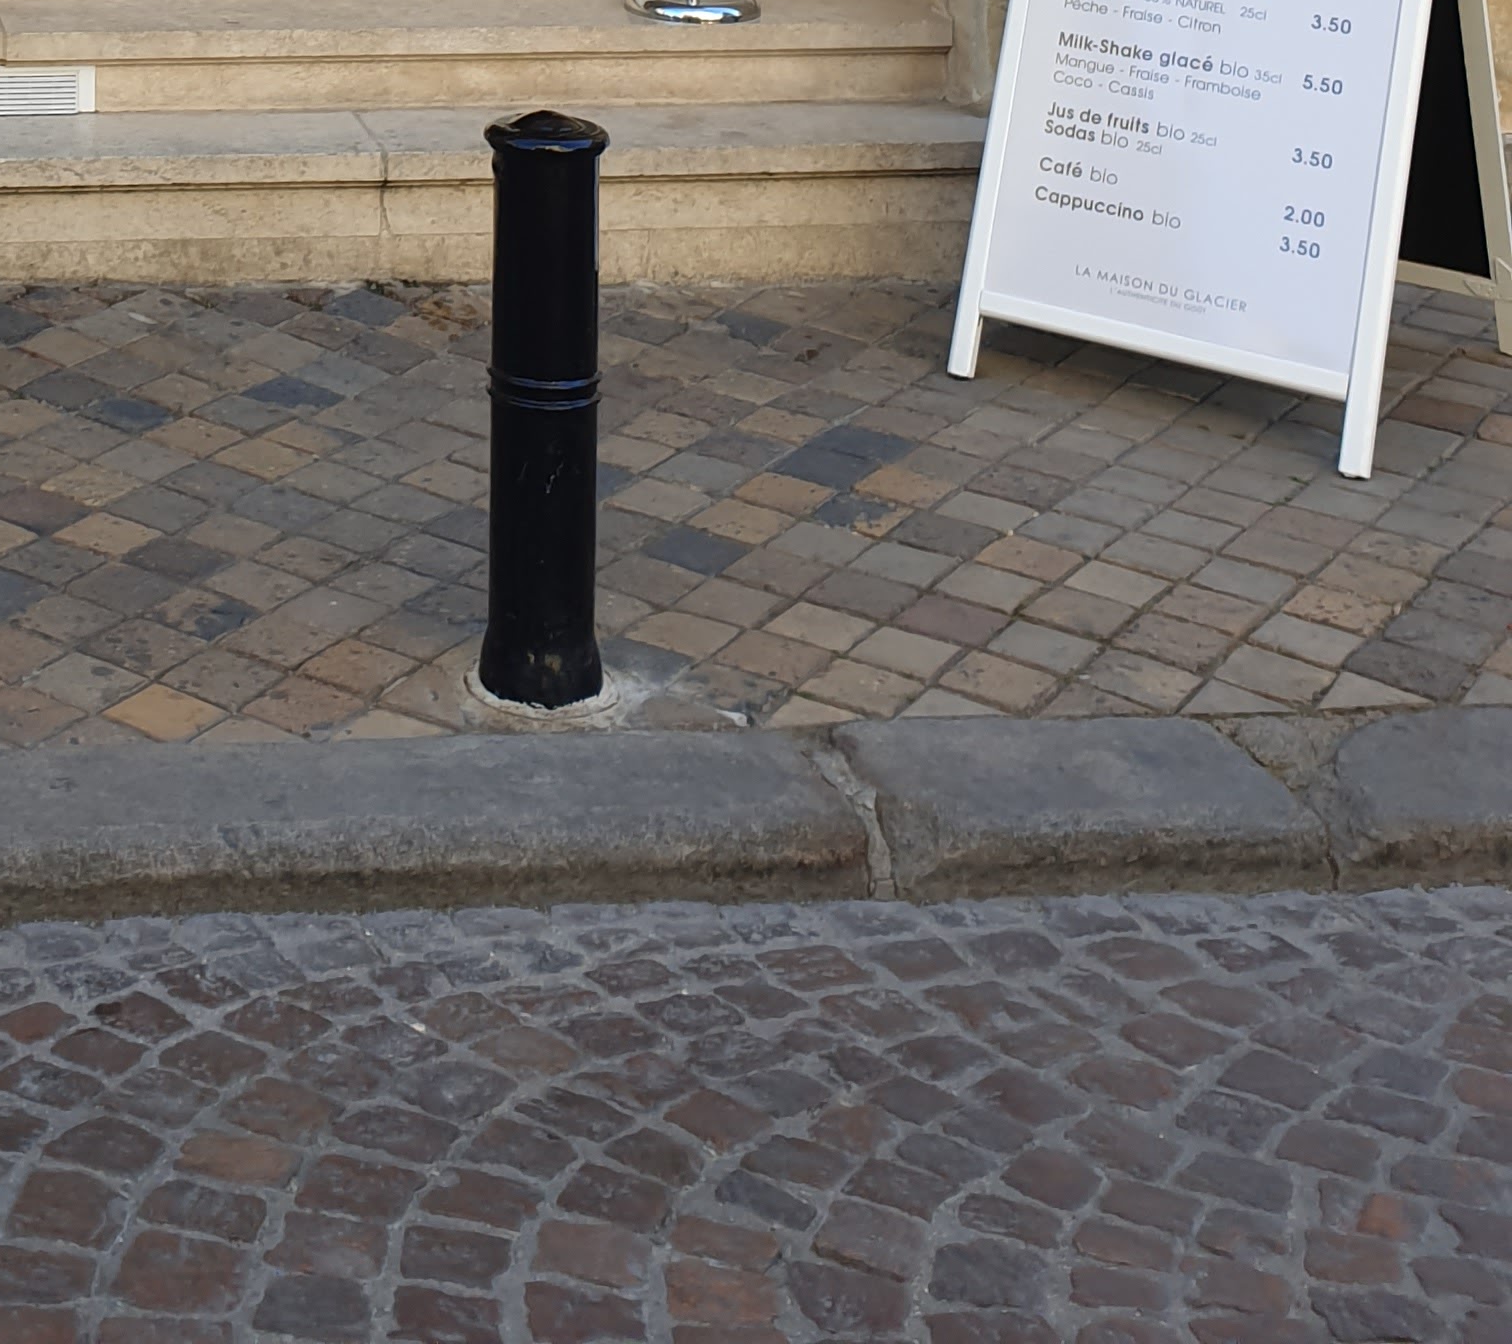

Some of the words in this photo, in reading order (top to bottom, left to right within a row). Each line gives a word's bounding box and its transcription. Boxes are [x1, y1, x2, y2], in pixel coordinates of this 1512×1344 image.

[1121, 5, 1164, 25] Fraise
[1176, 14, 1223, 36] Citron
[1239, 5, 1268, 22] 25cl
[1310, 13, 1353, 36] 3.50
[1057, 30, 1154, 63] Milk-Shake
[1158, 49, 1215, 75] glacé
[1219, 59, 1250, 80] bio
[1253, 68, 1284, 86] 35cl
[1052, 69, 1094, 90] Coco
[1107, 79, 1155, 101] Cassis
[1054, 51, 1115, 78] Mangue
[1128, 64, 1171, 86] Fraise
[1183, 74, 1263, 102] Framboise
[1301, 73, 1345, 97] 5.50
[1043, 119, 1097, 144] Sodas
[1100, 128, 1130, 150] bio
[1135, 139, 1163, 157] 25cl
[1046, 101, 1075, 121] Jus
[1079, 108, 1103, 127] de
[1106, 112, 1150, 135] fruits
[1155, 121, 1186, 142] bio
[1189, 130, 1218, 148] 25cl
[1038, 155, 1084, 180] Café
[1089, 165, 1120, 187] bio
[1291, 146, 1334, 171] 3.50
[1034, 184, 1145, 223] Cappuccino
[1150, 208, 1182, 231] bio
[1282, 204, 1326, 229] 2.00
[1278, 235, 1322, 260] 3.50
[1074, 263, 1092, 279] LA
[1096, 269, 1154, 293] MAISON
[1158, 282, 1179, 299] DU
[1182, 288, 1249, 313] GLACIER
